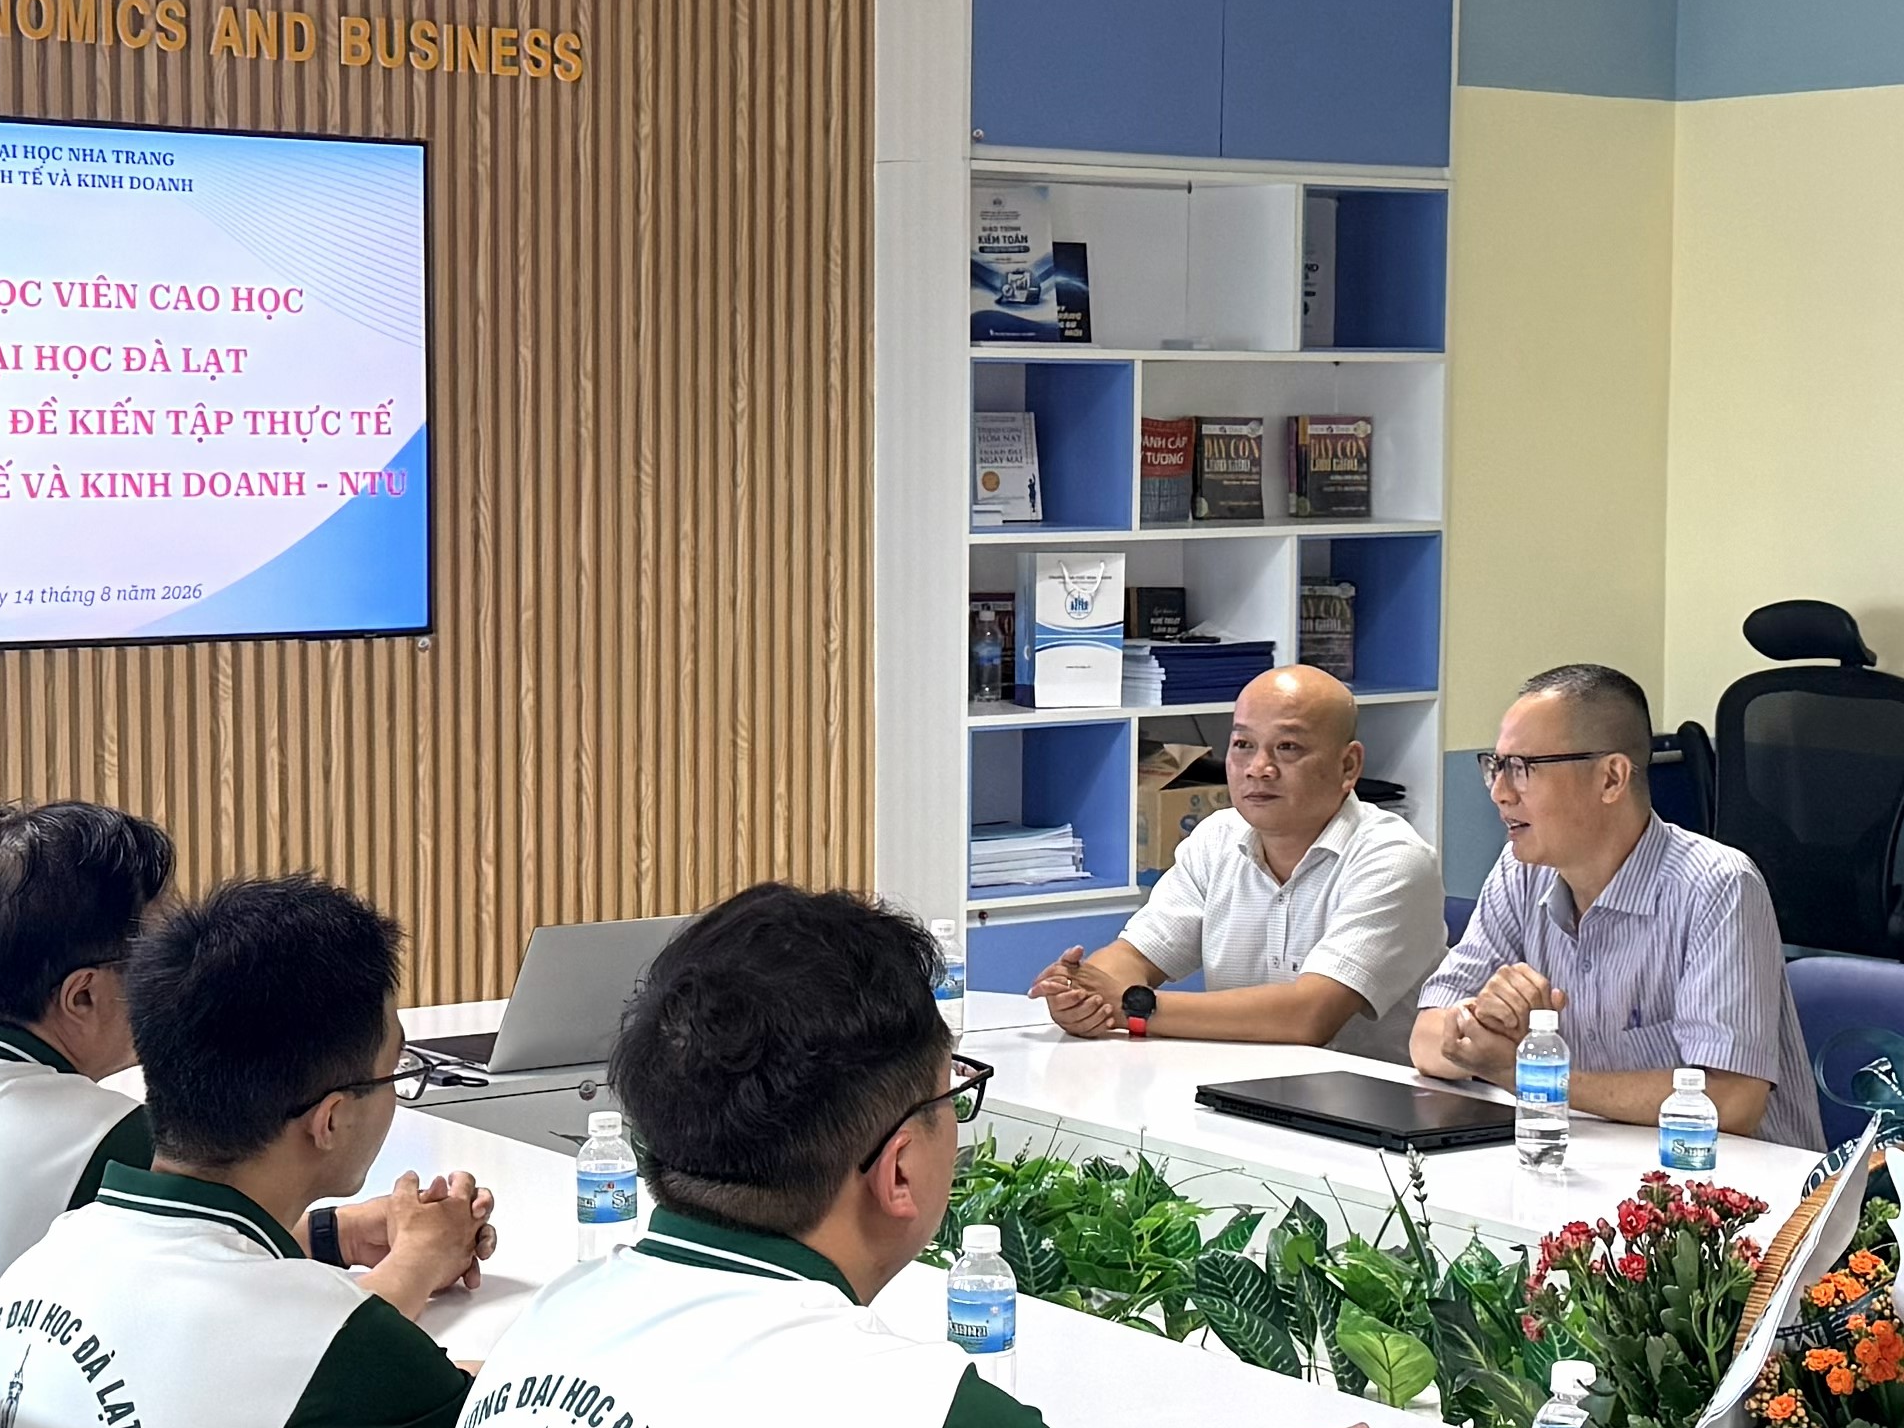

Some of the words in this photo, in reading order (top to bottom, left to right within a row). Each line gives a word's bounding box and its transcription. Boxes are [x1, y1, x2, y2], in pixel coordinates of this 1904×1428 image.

[210, 7, 317, 63] AND
[340, 14, 584, 83] BUSINESS
[22, 144, 63, 168] HỌC
[67, 148, 108, 164] NHA
[111, 149, 175, 167] TRANG
[18, 164, 44, 186] TẾ
[47, 167, 73, 187] VÀ
[77, 172, 124, 190] KINH
[129, 176, 194, 193] DOANH
[53, 274, 138, 310] VIÊN
[149, 284, 221, 313] CAO
[231, 286, 305, 320] HỌC
[34, 344, 112, 380] HỌC
[123, 338, 172, 374] ĐÀ
[182, 347, 248, 381] LẠT
[8, 395, 58, 436] ĐỀ
[68, 396, 156, 437] KIẾN
[166, 402, 234, 443] TẬP
[243, 404, 342, 443] THỰC
[351, 398, 395, 437] TẾ
[21, 464, 71, 500] VÀ
[80, 471, 173, 499] KINH
[182, 471, 307, 498] DOANH
[338, 470, 408, 498] NTU
[14, 588, 34, 605] 14
[40, 585, 96, 608] tháng
[100, 585, 112, 602] 8
[116, 585, 156, 601] năm
[161, 582, 203, 600] 2026
[7, 1299, 43, 1334] ĐẠI
[39, 1303, 82, 1346] HỌC
[72, 1334, 116, 1383] ĐÀ
[516, 1374, 565, 1414] ĐẠI
[559, 1377, 615, 1428] HỌC
